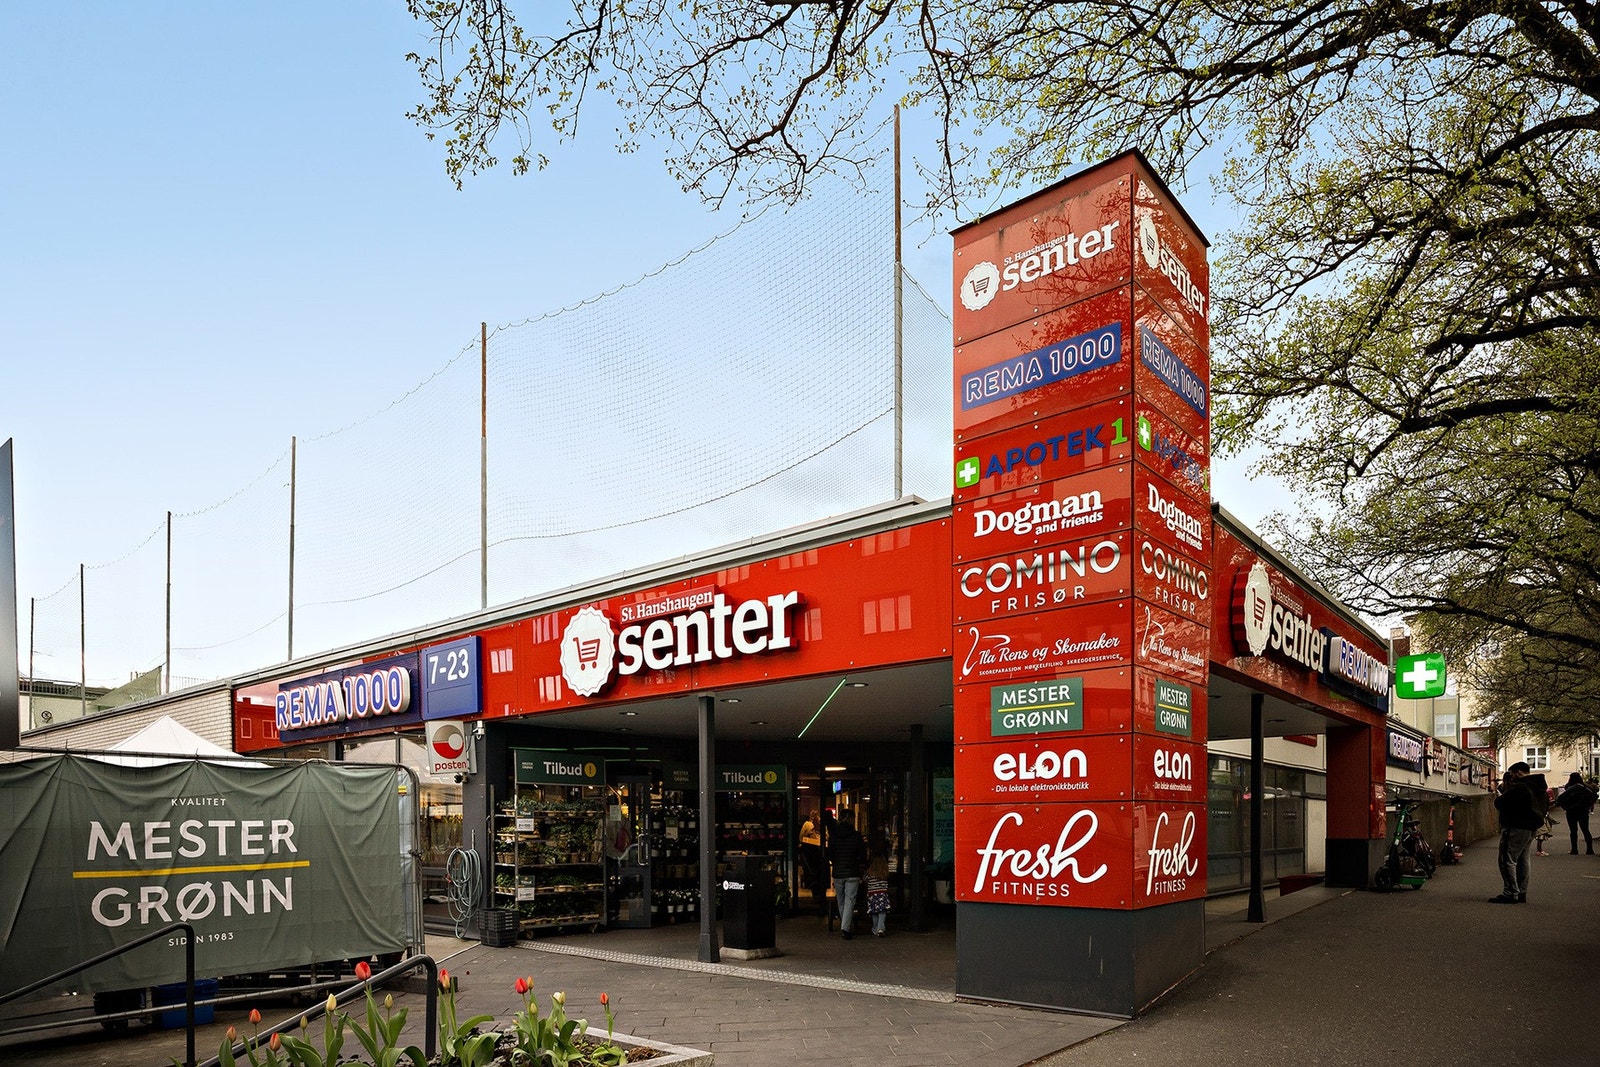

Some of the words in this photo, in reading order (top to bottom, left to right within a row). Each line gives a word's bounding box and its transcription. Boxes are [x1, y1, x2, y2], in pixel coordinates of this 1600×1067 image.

[1002, 220, 1120, 292] senter
[1014, 234, 1067, 261] Hanshaugen
[1160, 247, 1206, 318] senter
[966, 359, 1043, 404] REMA
[1050, 332, 1115, 375] 1000
[1142, 332, 1179, 388] REMA
[1179, 367, 1206, 410] 1000
[985, 424, 1105, 479] APOTEK
[1111, 418, 1128, 446] 1
[973, 490, 1104, 537] Dogman
[1035, 522, 1057, 536] and
[1060, 510, 1104, 531] friends
[1148, 482, 1202, 541] Dogman
[960, 540, 1121, 598] COMINO
[1140, 541, 1208, 600] COMINO
[621, 606, 636, 623] St.
[636, 591, 713, 619] Hanshaugen
[991, 585, 1086, 614] FRISØR
[1155, 586, 1197, 616] FRISØR
[618, 590, 799, 676] senter
[995, 647, 1030, 663] Rens
[1032, 646, 1049, 661] og
[1053, 633, 1120, 656] Skomaker
[1271, 604, 1328, 674] senter
[428, 647, 470, 685] 7-23
[1340, 638, 1369, 686] REMA
[275, 679, 340, 731] REMA
[343, 667, 411, 718] 1000
[1001, 684, 1071, 706] MESTER
[1160, 686, 1188, 707] MESTER
[1003, 708, 1069, 730] GRØNN
[1160, 710, 1188, 730] GRØNN
[433, 759, 468, 774] posten
[543, 761, 583, 777] Tilbud
[722, 771, 763, 784] Tilbud
[171, 798, 227, 807] KVALITET
[995, 785, 1008, 793] Din
[1008, 784, 1029, 792] lokale
[1030, 781, 1090, 792] elektronikkbutikk
[87, 819, 298, 861] MESTER
[973, 809, 1107, 893] fresh
[1146, 811, 1199, 896] fresh
[91, 877, 294, 928] GRØNN
[992, 881, 1071, 897] FITNESS
[1154, 878, 1187, 895] FITNESS
[168, 935, 204, 947] SIDN
[208, 932, 235, 943] 1983
